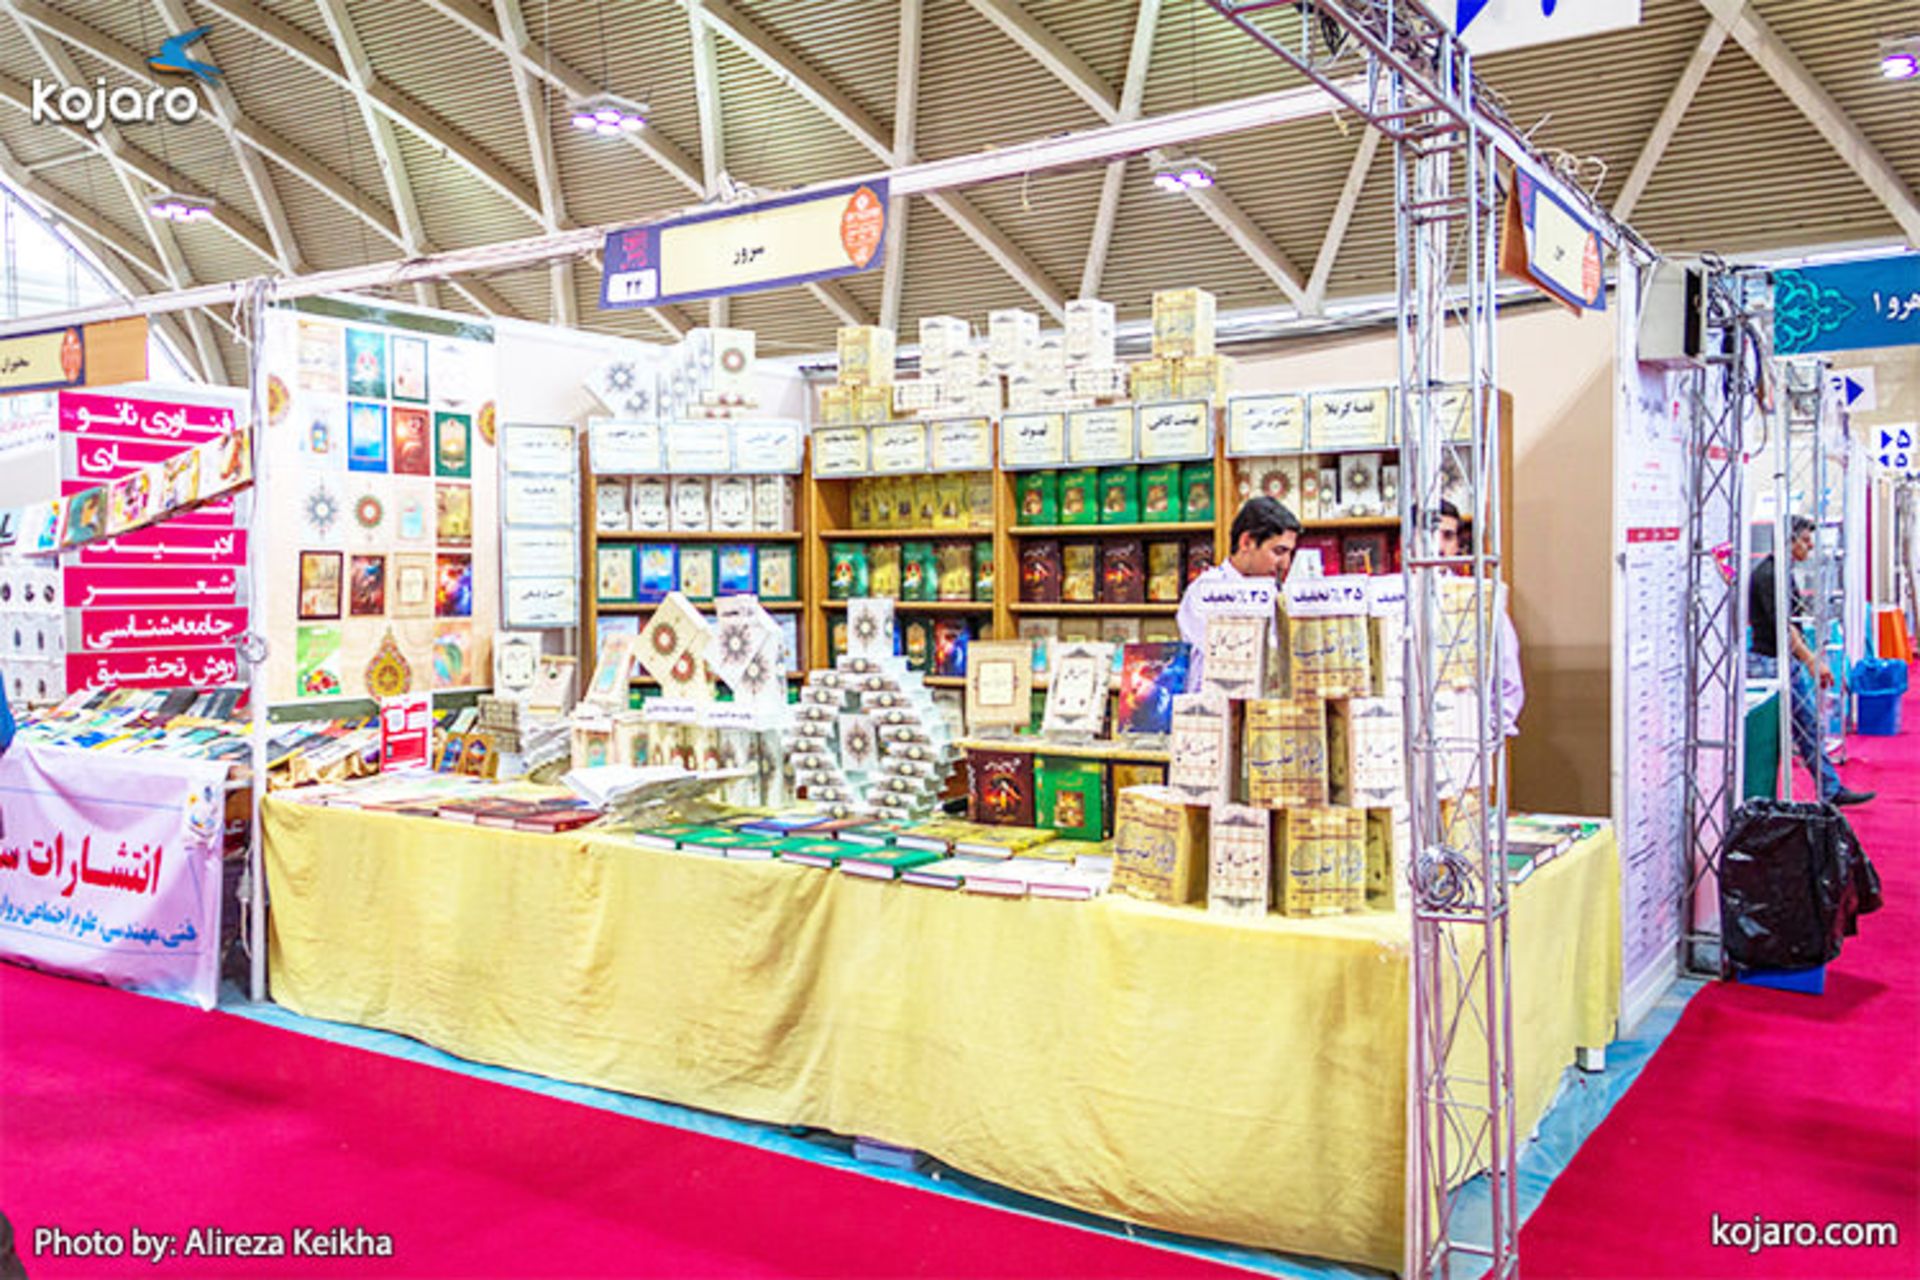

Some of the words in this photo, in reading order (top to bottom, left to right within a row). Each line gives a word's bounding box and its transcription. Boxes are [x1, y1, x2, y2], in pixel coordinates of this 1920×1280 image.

[76, 402, 139, 432] نانو
[81, 575, 236, 605] شعر
[87, 656, 187, 691] تحقیق
[189, 656, 237, 686] روش
[28, 831, 163, 898] انتشارات
